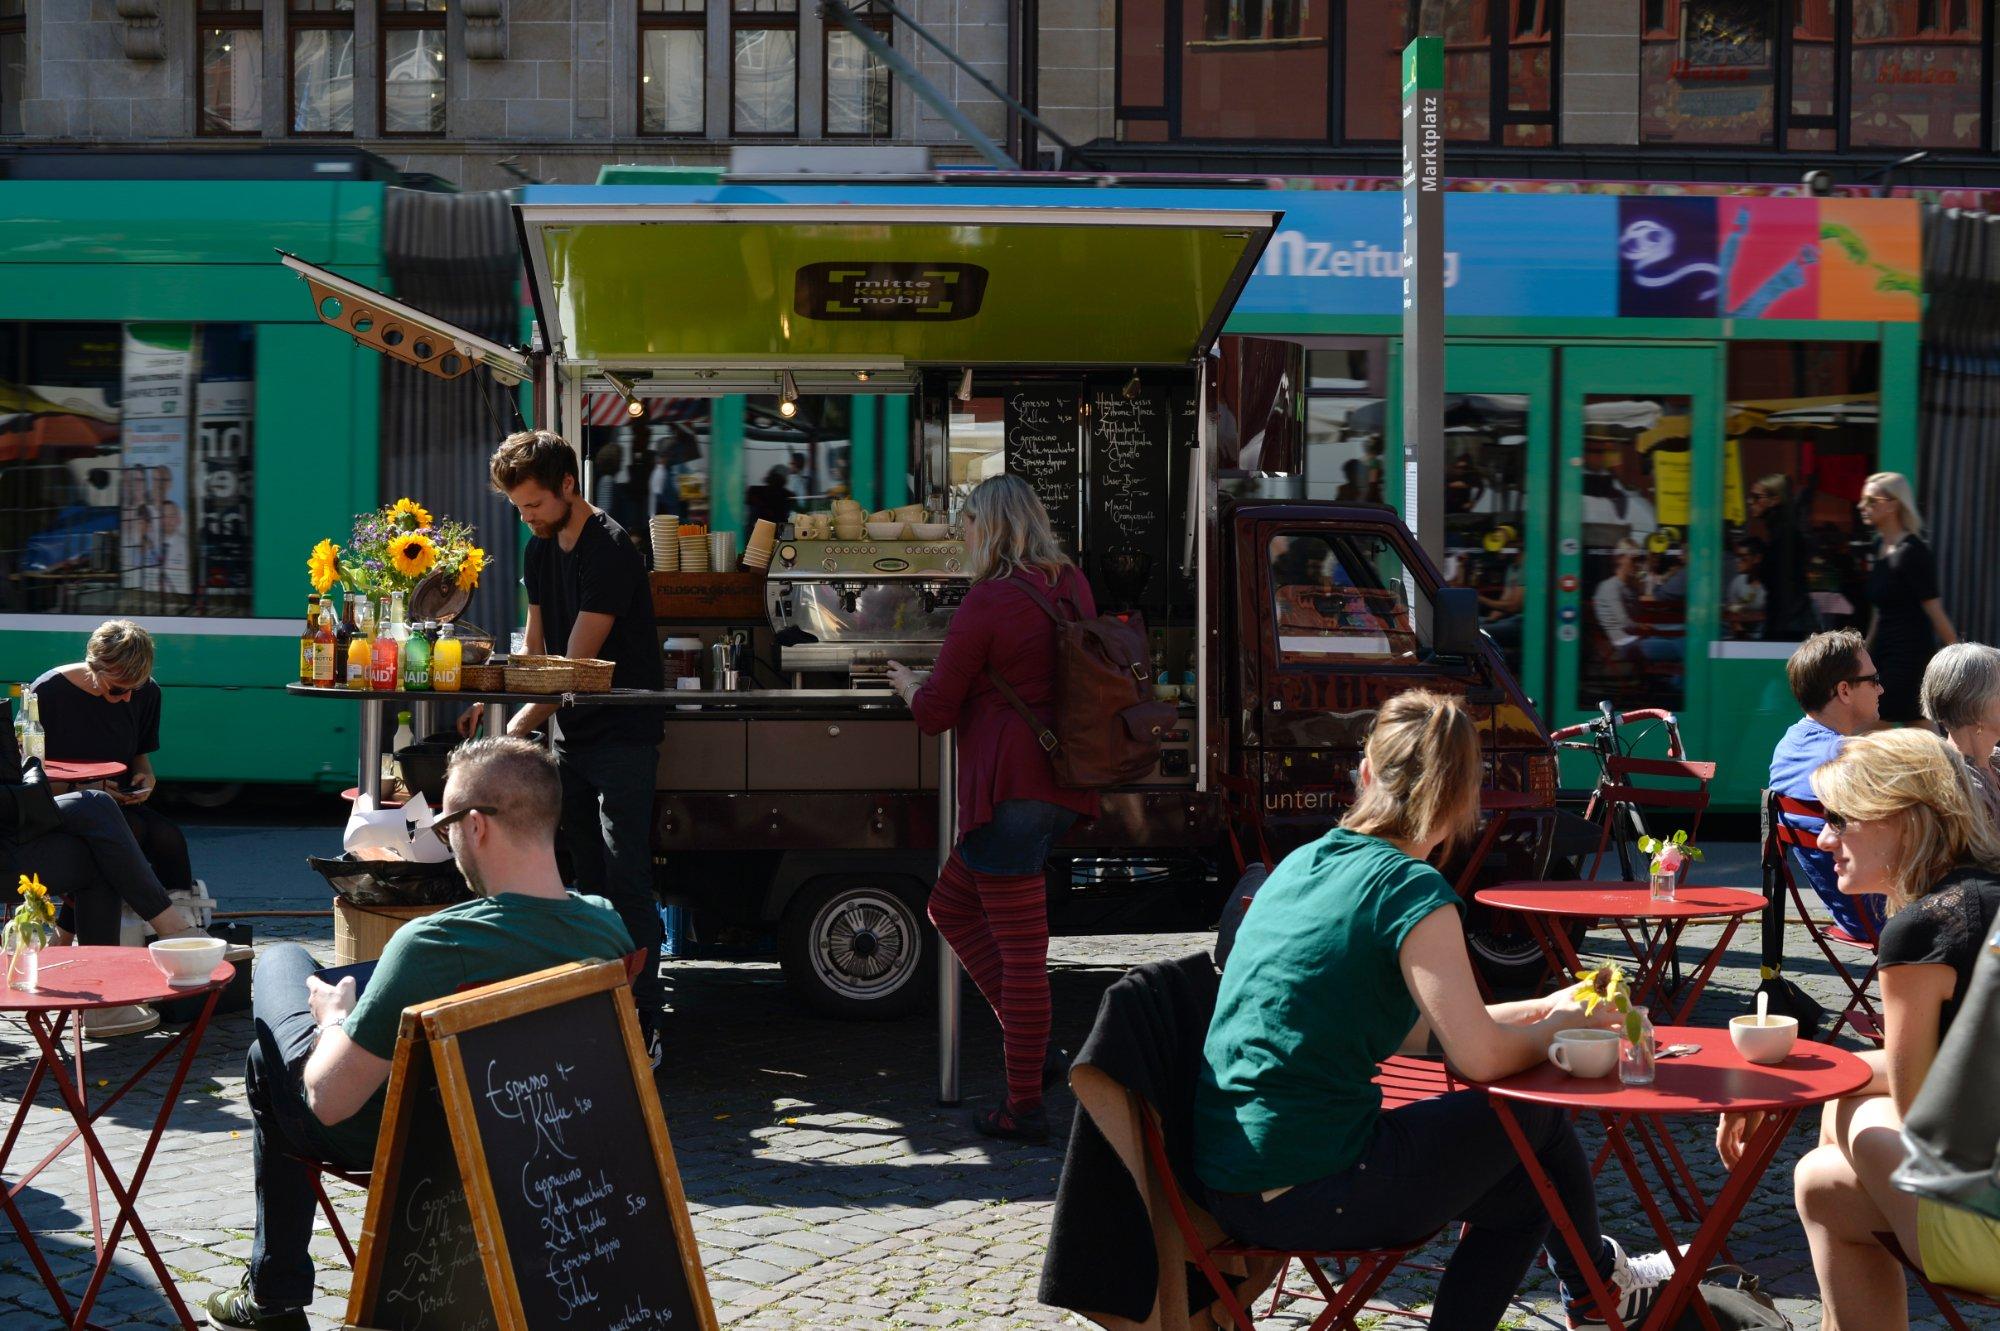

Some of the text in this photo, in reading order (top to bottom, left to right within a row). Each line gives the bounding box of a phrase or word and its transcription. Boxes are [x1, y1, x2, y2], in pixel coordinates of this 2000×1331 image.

[1421, 97, 1441, 192] Marktplatz
[855, 280, 932, 288] mitte
[855, 288, 930, 296] Kaffee
[853, 296, 928, 305] mobil
[1010, 393, 1050, 414] Espresso
[1019, 409, 1048, 431] Kaffee
[1009, 427, 1057, 447] Cappuccino
[1010, 454, 1046, 471] Espresso
[486, 1059, 549, 1124] Espresso
[524, 1091, 593, 1160] Kaffee 4,50
[522, 1161, 582, 1208] Cappuccino
[626, 1194, 647, 1216] 5,50
[546, 1237, 621, 1286] Espresso doppio
